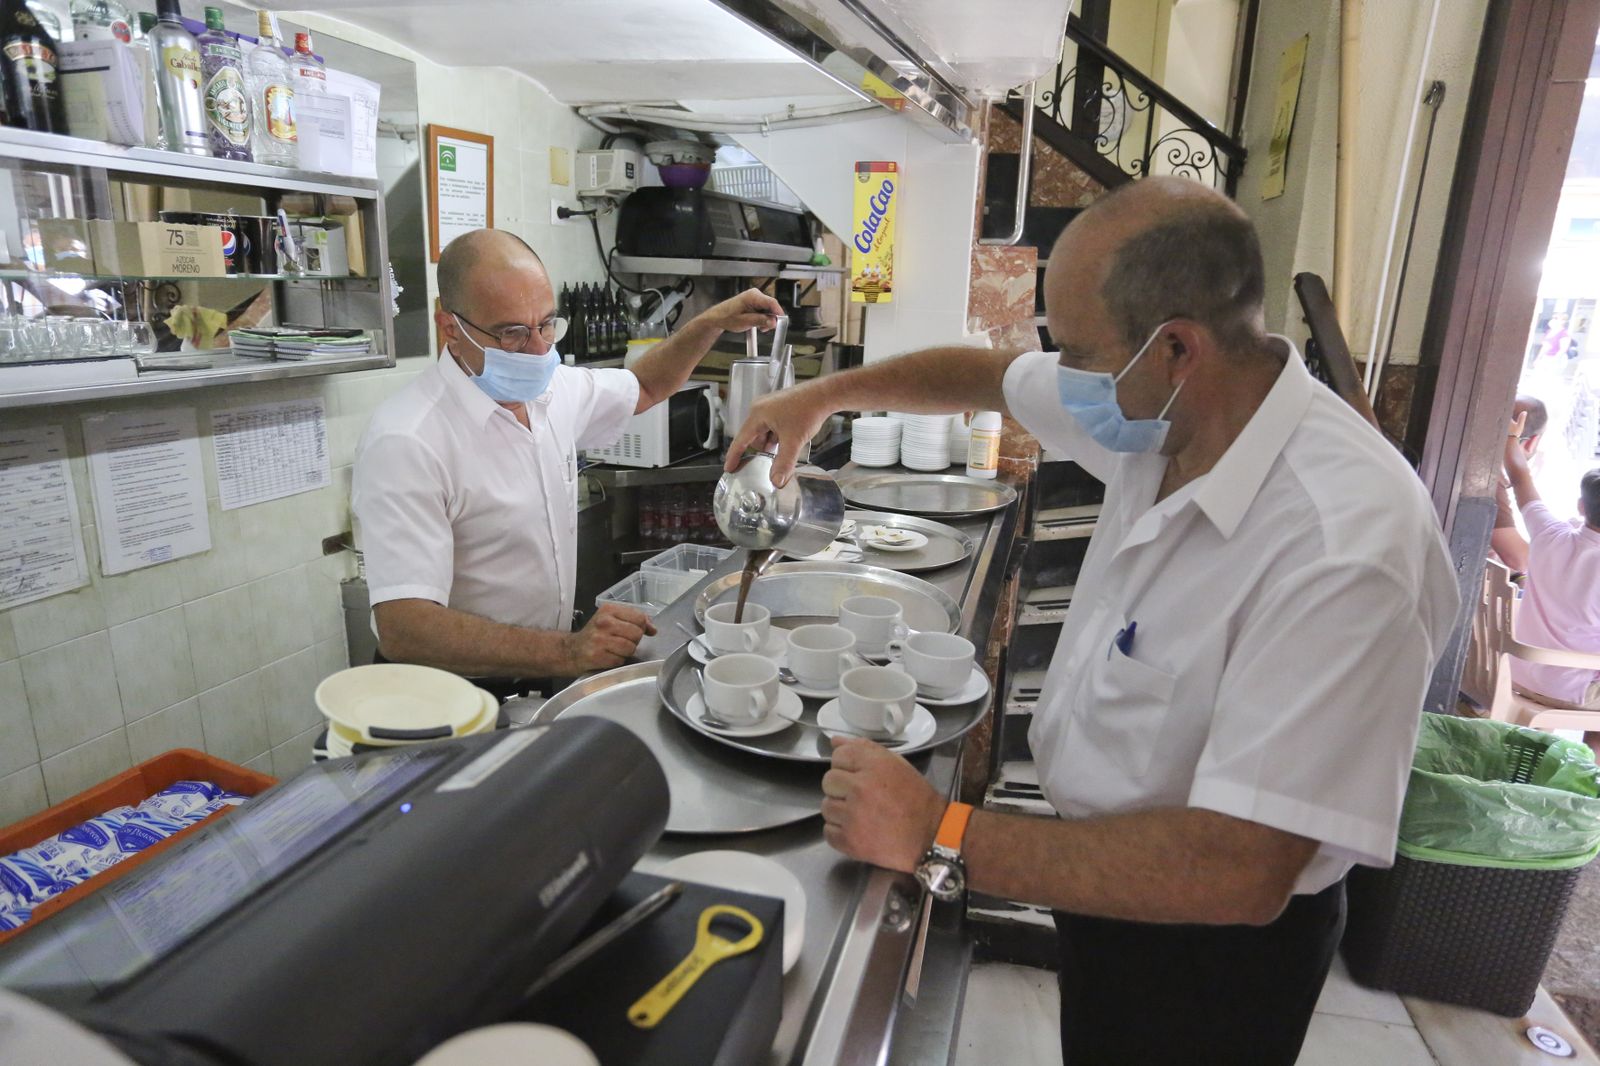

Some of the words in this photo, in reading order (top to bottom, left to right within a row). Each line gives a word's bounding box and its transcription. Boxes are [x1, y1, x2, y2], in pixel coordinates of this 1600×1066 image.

[854, 179, 895, 254] ColaCao
[166, 229, 184, 246] 75
[172, 263, 201, 274] MORENO
